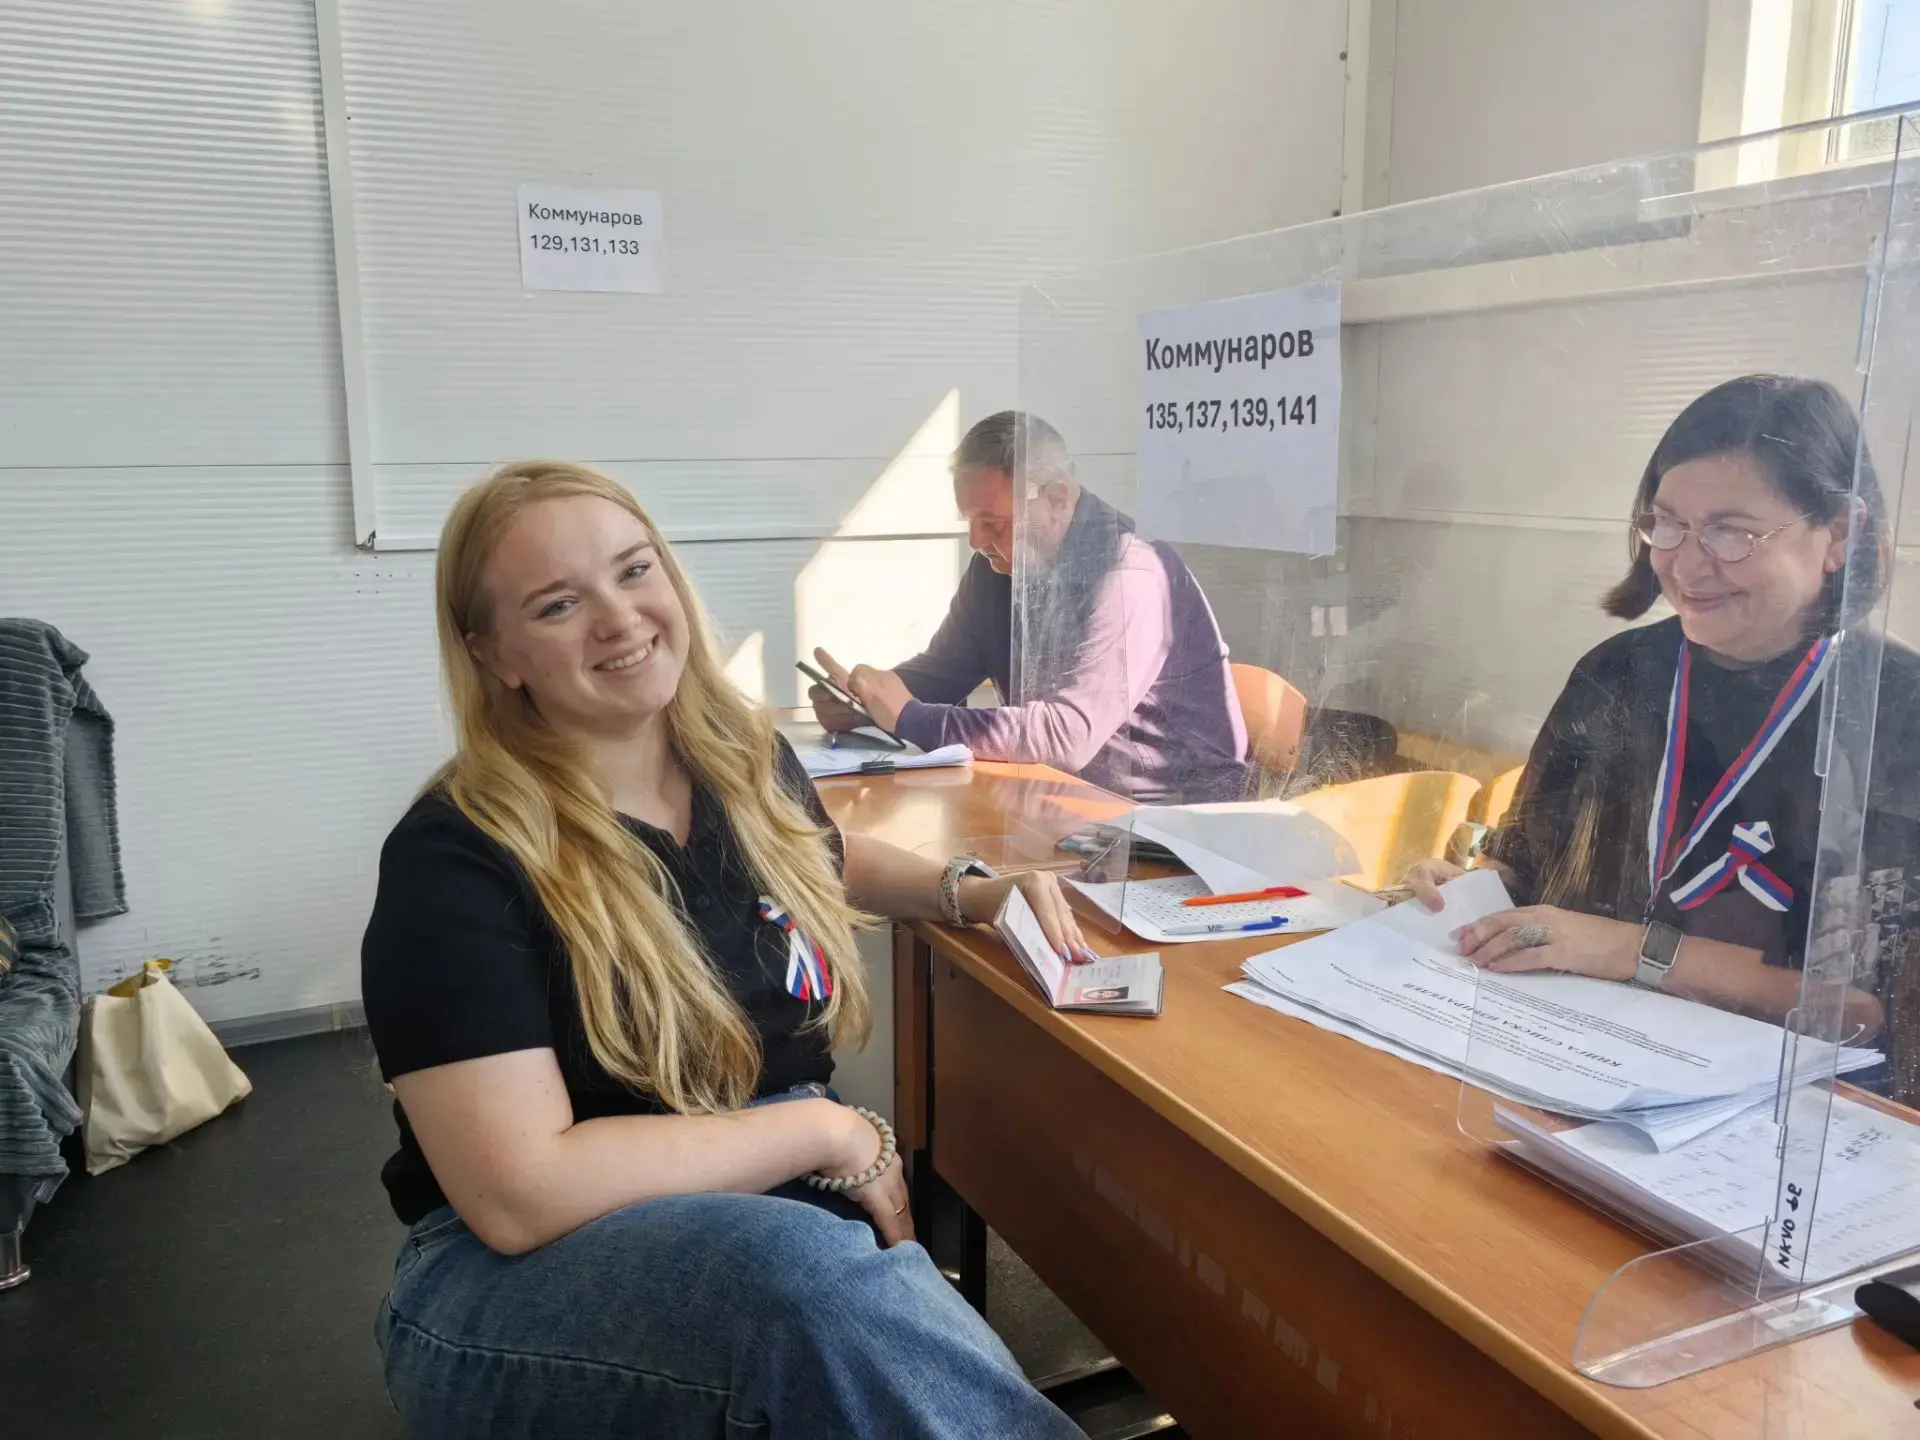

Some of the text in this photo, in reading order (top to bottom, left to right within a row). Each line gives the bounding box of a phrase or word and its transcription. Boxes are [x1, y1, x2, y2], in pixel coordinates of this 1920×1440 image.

[528, 202, 643, 227] Коммунаров
[530, 234, 640, 255] 129,131,133
[1146, 329, 1315, 373] Коммунаров
[1146, 394, 1317, 433] 135,137,139,141
